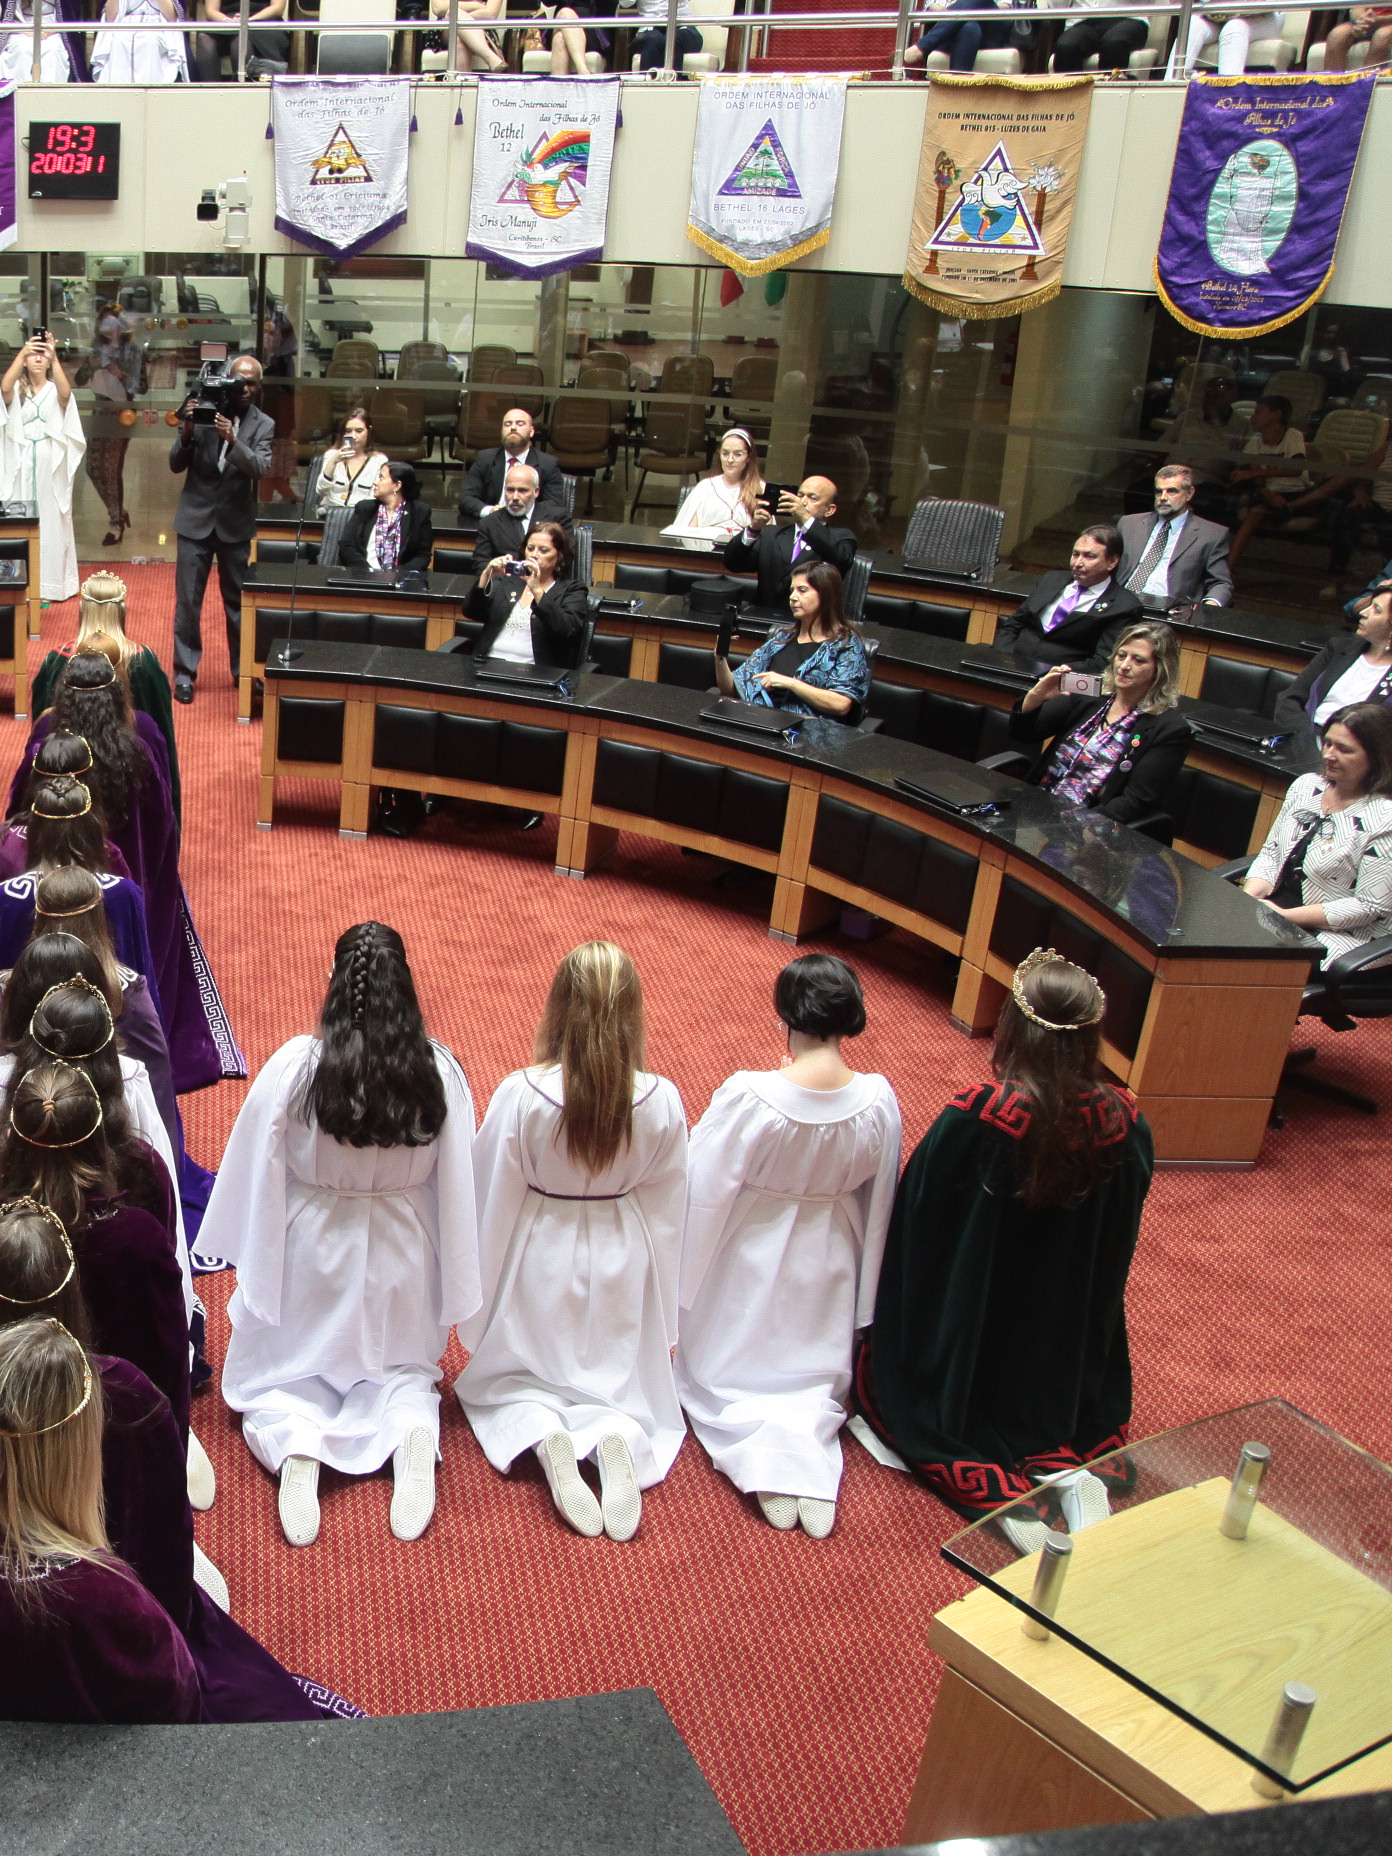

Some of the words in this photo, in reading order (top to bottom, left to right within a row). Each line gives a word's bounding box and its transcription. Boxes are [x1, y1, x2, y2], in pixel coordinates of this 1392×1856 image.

[285, 98, 318, 108] Ordem
[324, 92, 396, 107] Internacional
[713, 91, 749, 100] ORDEM
[753, 91, 830, 100] INTERNACIONAL
[492, 98, 517, 108] Ordem
[518, 99, 568, 108] Internacional
[725, 101, 745, 110] DAS
[749, 101, 783, 109] FILHAS
[787, 101, 800, 110] DE
[804, 100, 816, 110] JÓ
[1219, 97, 1252, 110] Ordem
[1254, 96, 1311, 110] Internacional
[1312, 96, 1331, 108] das
[297, 110, 314, 119] das
[320, 107, 351, 119] Filhas
[357, 107, 368, 116] de
[374, 106, 385, 117] Jó
[938, 112, 960, 120] ORDEM
[963, 112, 1014, 121] INTERNACIONAL
[1016, 113, 1029, 121] DAS
[1031, 113, 1053, 121] FILHAS
[1065, 112, 1075, 122] JÓ
[539, 113, 551, 122] das
[552, 113, 579, 125] Filhas
[579, 114, 588, 122] de
[588, 113, 601, 125] Jó
[1244, 111, 1272, 126] Filhas
[1274, 113, 1285, 125] de
[489, 121, 525, 139] Bethel
[960, 124, 983, 132] BETHEL
[1031, 125, 1046, 133] GAIA
[500, 142, 512, 152] 12
[295, 192, 326, 202] Bethel
[713, 203, 752, 212] BETHEL
[758, 204, 768, 212] 16
[773, 205, 806, 215] LAGES
[524, 242, 545, 250] Brasil
